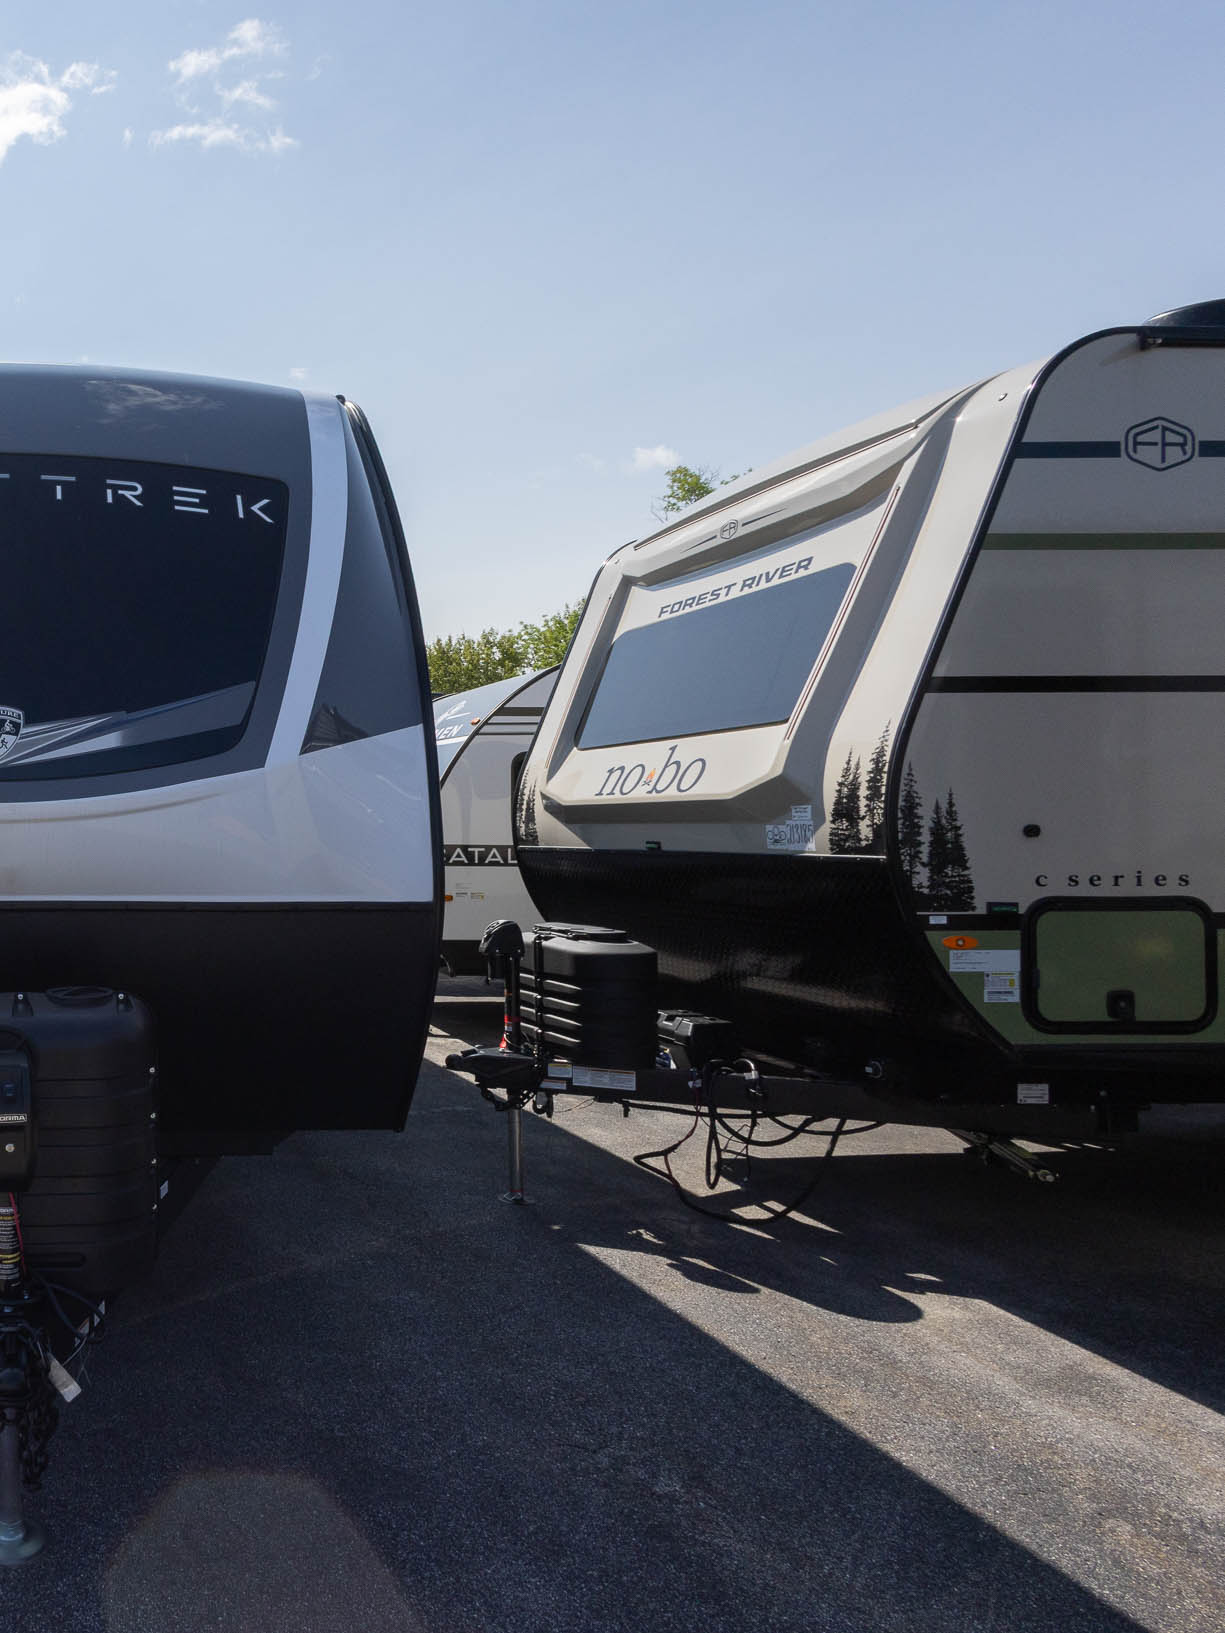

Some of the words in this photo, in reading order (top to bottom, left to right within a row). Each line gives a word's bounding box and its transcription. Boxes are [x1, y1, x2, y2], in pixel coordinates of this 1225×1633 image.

[657, 582, 737, 618] FOREST
[739, 556, 814, 592] RIVER
[1066, 869, 1191, 888] series
